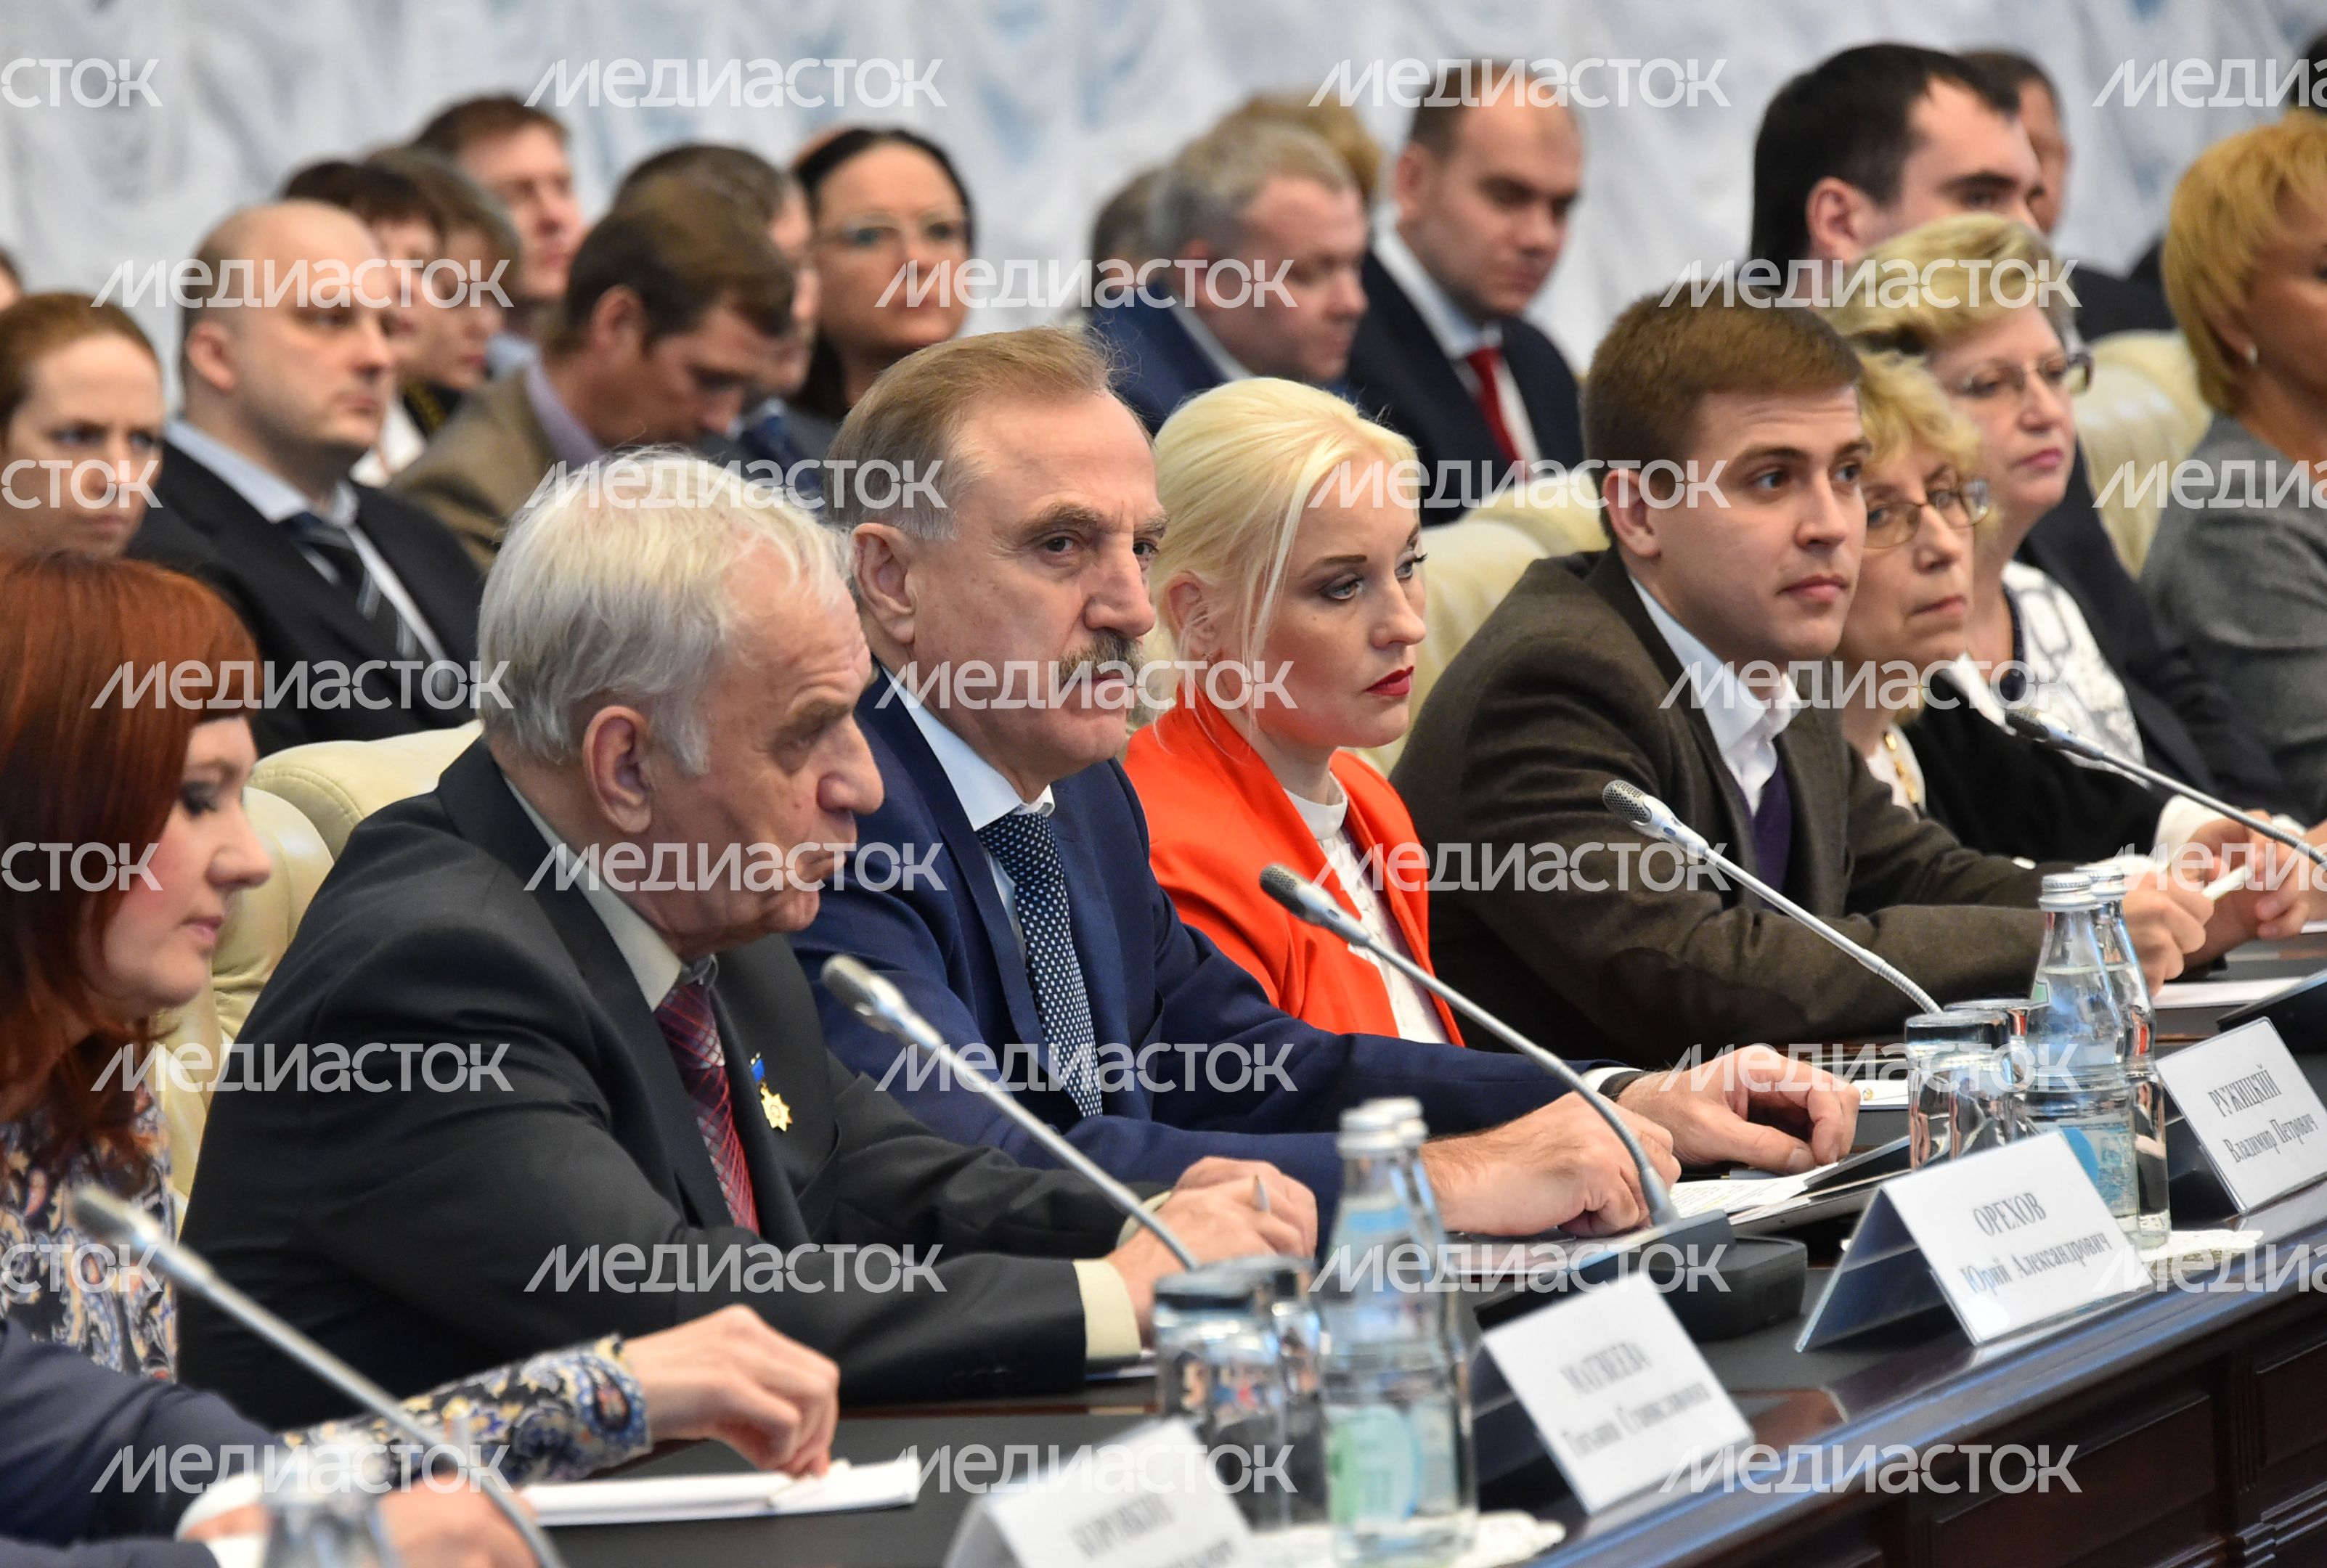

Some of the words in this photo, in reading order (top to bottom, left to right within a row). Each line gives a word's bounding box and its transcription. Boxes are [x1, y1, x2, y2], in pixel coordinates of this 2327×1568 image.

[2208, 1064, 2282, 1117] РУЖИЦКИЙ
[2224, 1130, 2281, 1163] Владимир
[2270, 1114, 2319, 1145] Петрович
[1973, 1193, 2047, 1236] ОРЕХОВ
[1960, 1257, 2013, 1295] Юрий
[2011, 1233, 2113, 1278] Александрович
